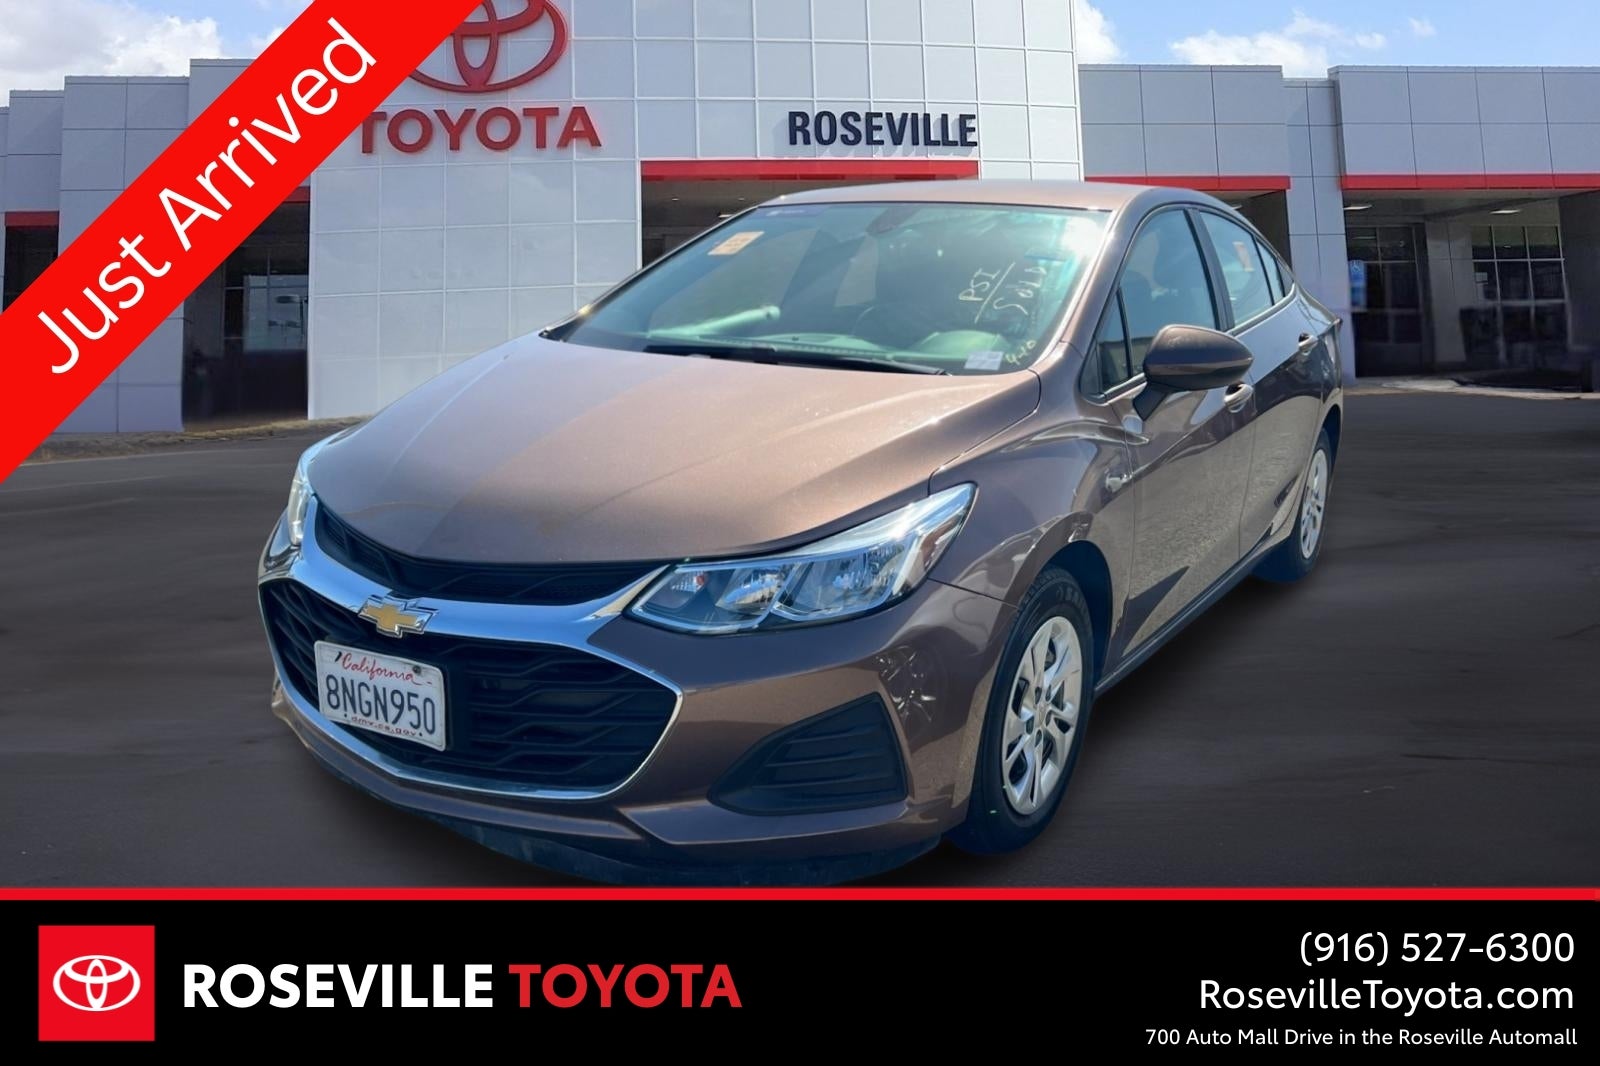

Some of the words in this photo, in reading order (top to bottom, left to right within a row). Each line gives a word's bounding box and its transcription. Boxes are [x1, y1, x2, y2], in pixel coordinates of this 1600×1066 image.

[360, 106, 601, 154] TOYOTA
[788, 110, 978, 147] ROSEVILLE
[341, 652, 424, 686] California
[325, 674, 437, 736] 8NGN950
